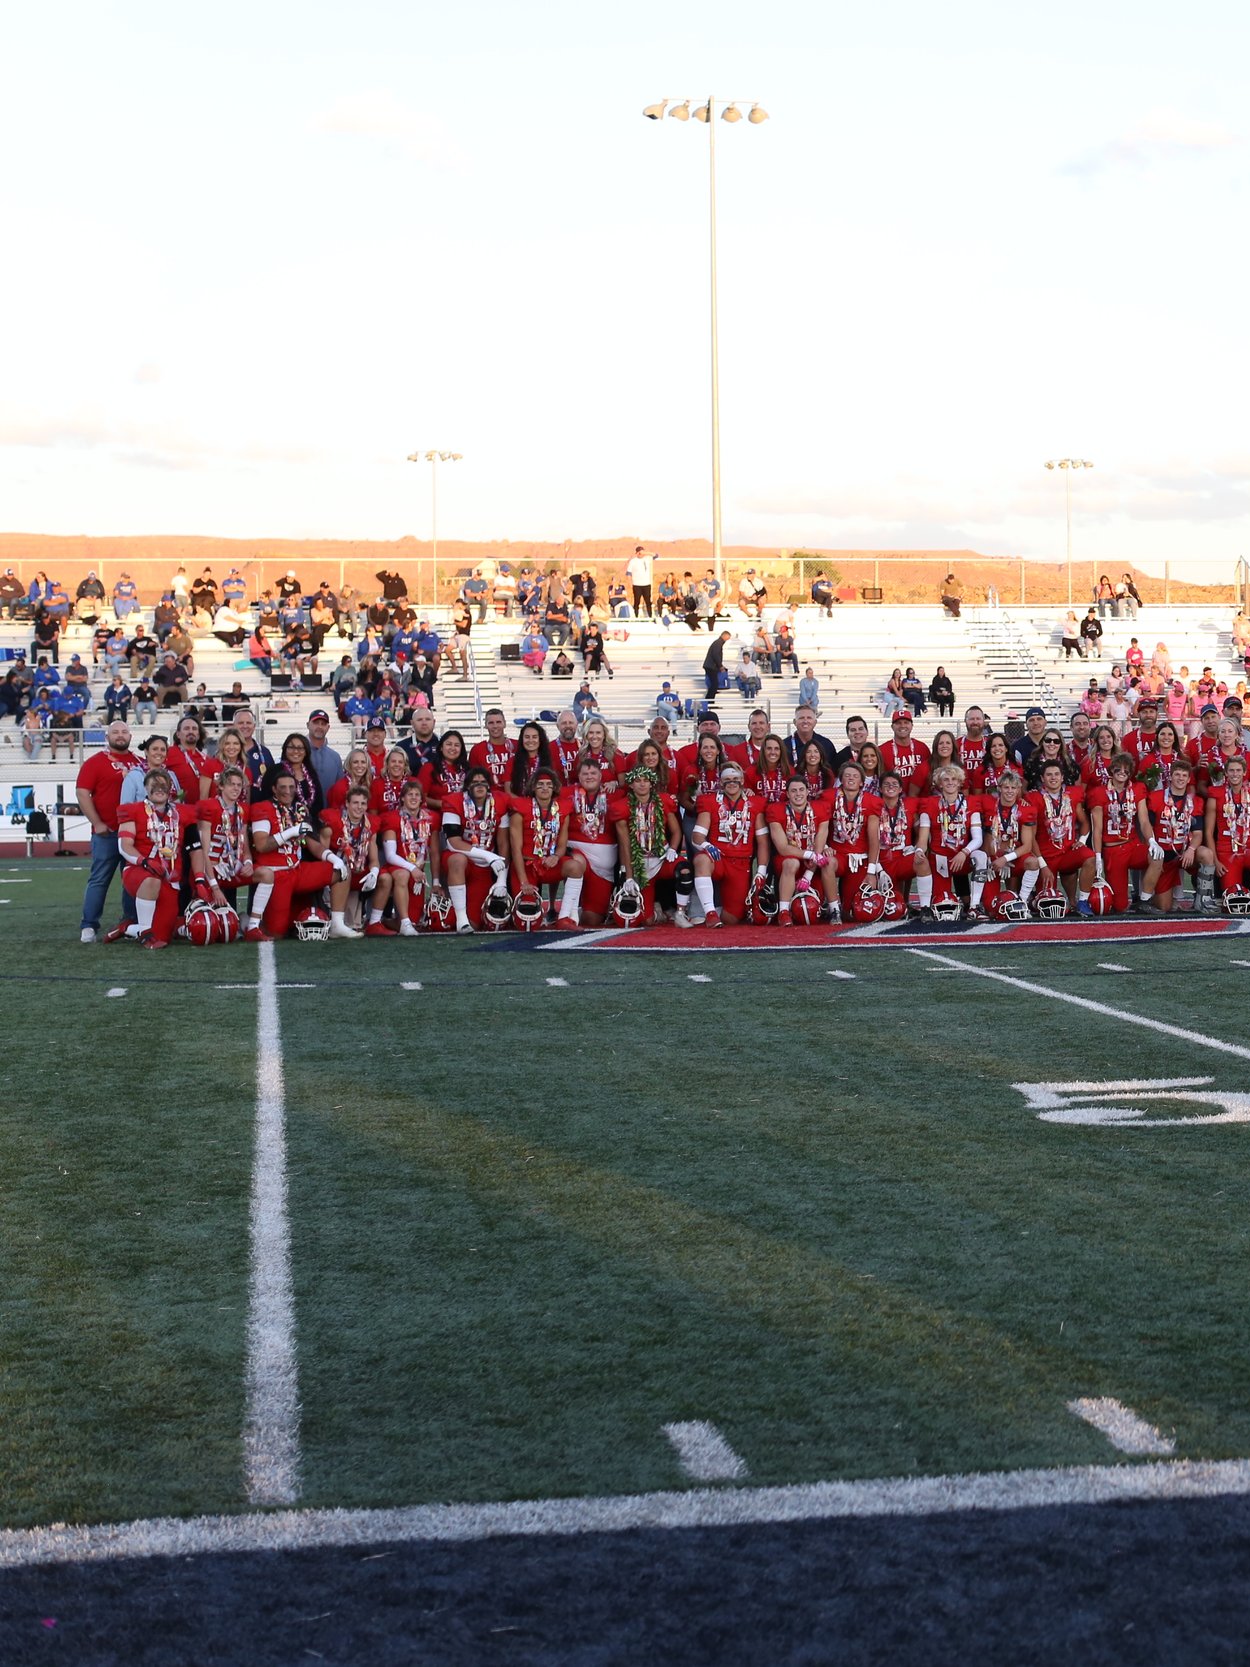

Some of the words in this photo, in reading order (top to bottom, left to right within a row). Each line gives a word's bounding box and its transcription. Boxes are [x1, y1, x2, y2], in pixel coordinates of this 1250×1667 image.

[486, 752, 509, 764] GAM
[894, 754, 922, 767] GAME
[962, 749, 984, 760] GAM
[862, 900, 874, 914] 87
